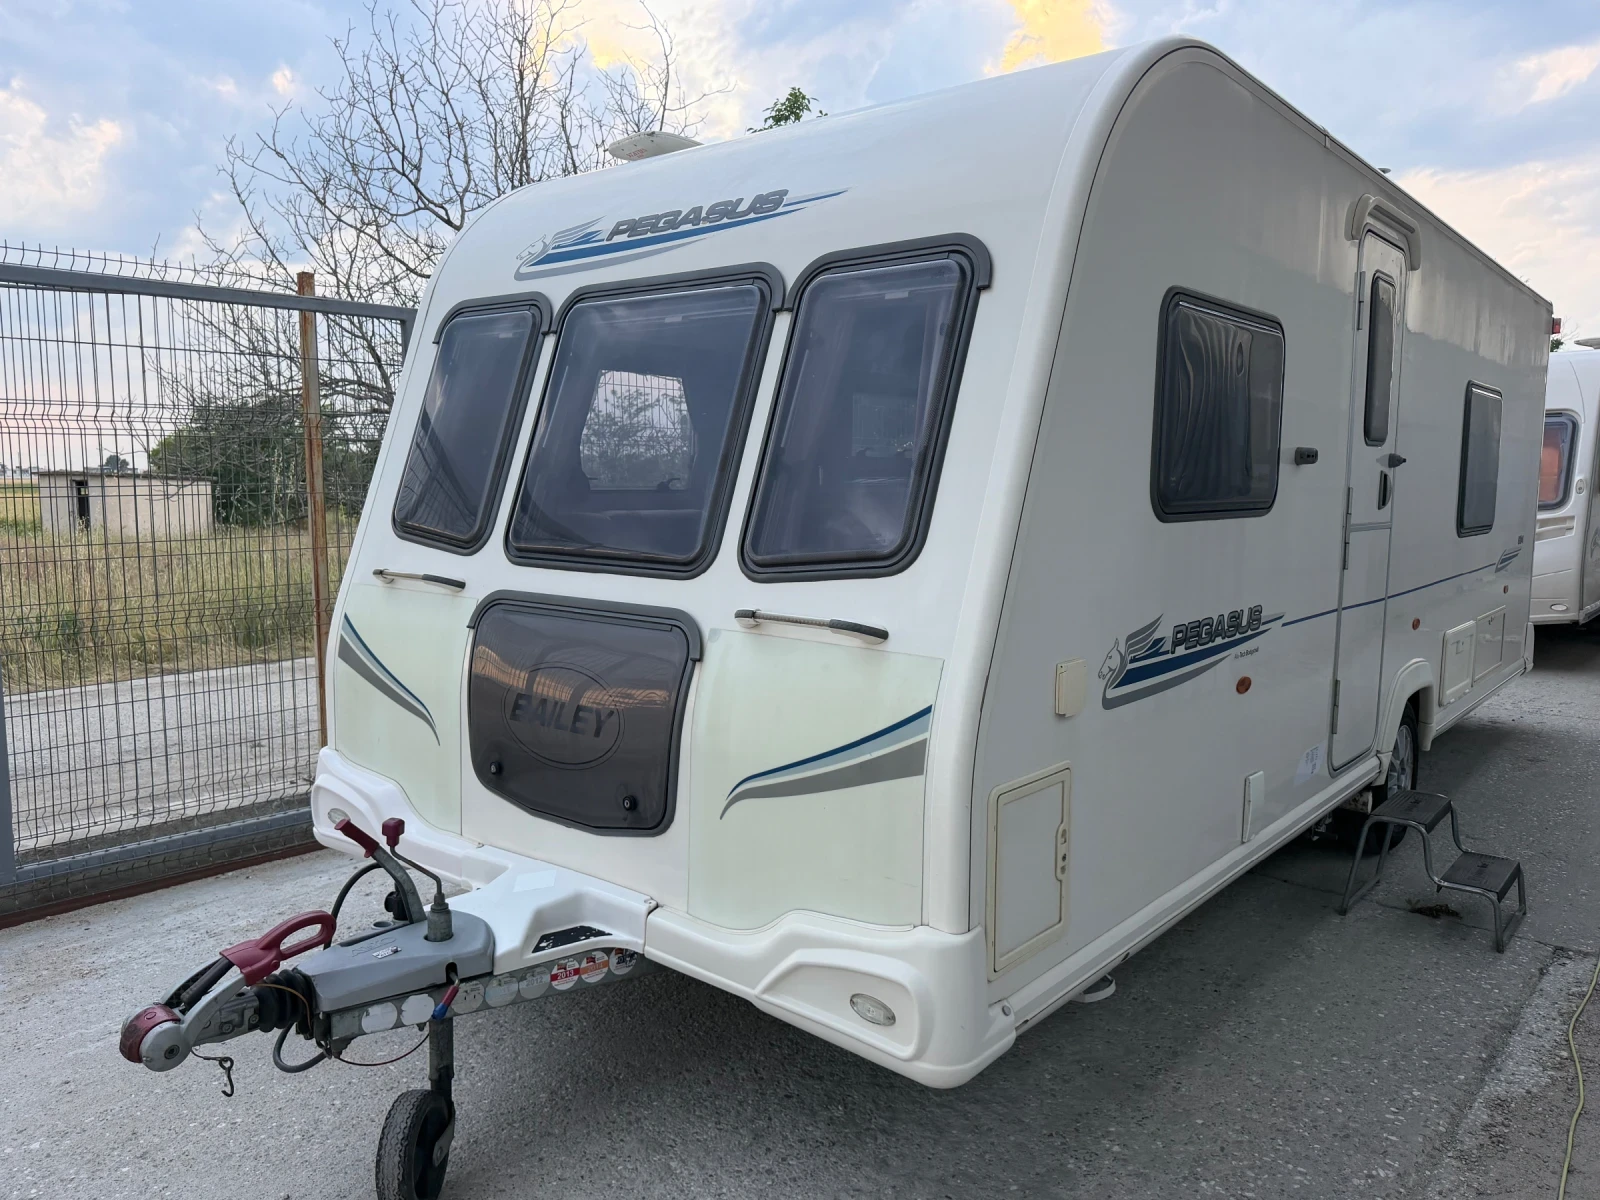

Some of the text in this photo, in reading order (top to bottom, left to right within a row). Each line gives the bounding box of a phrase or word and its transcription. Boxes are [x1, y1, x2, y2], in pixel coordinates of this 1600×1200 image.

[605, 188, 789, 242] PEGASUS
[1170, 604, 1262, 655] PEGASUS
[510, 692, 614, 738] BAILEY
[557, 970, 574, 980] 2013
